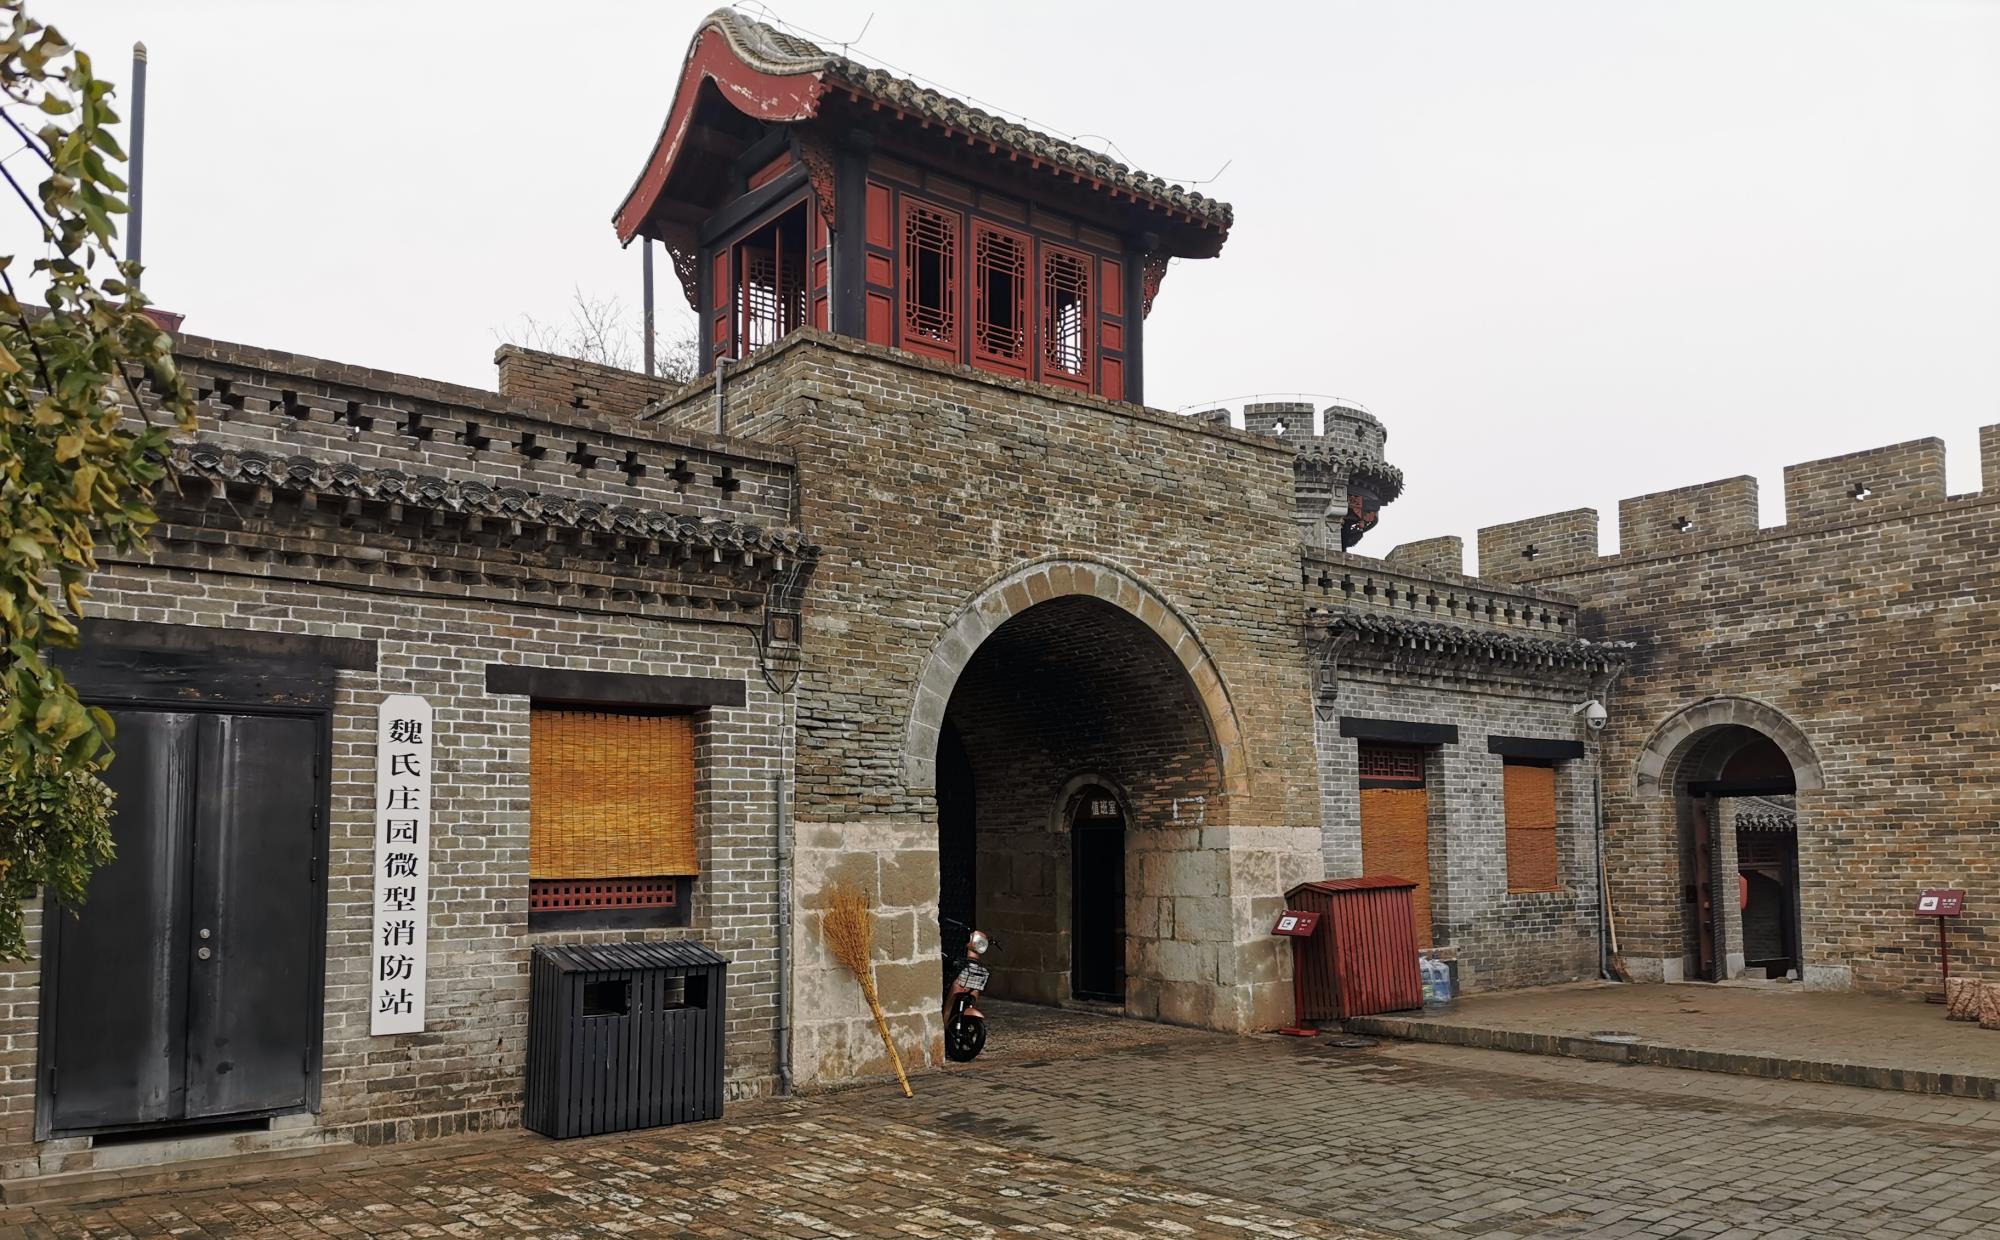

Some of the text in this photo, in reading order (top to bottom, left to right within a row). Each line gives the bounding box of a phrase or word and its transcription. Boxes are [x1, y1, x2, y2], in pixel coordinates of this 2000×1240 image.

[379, 718, 423, 1015] 魏氏庄园微型消防站
[1092, 800, 1117, 815] 值班室
